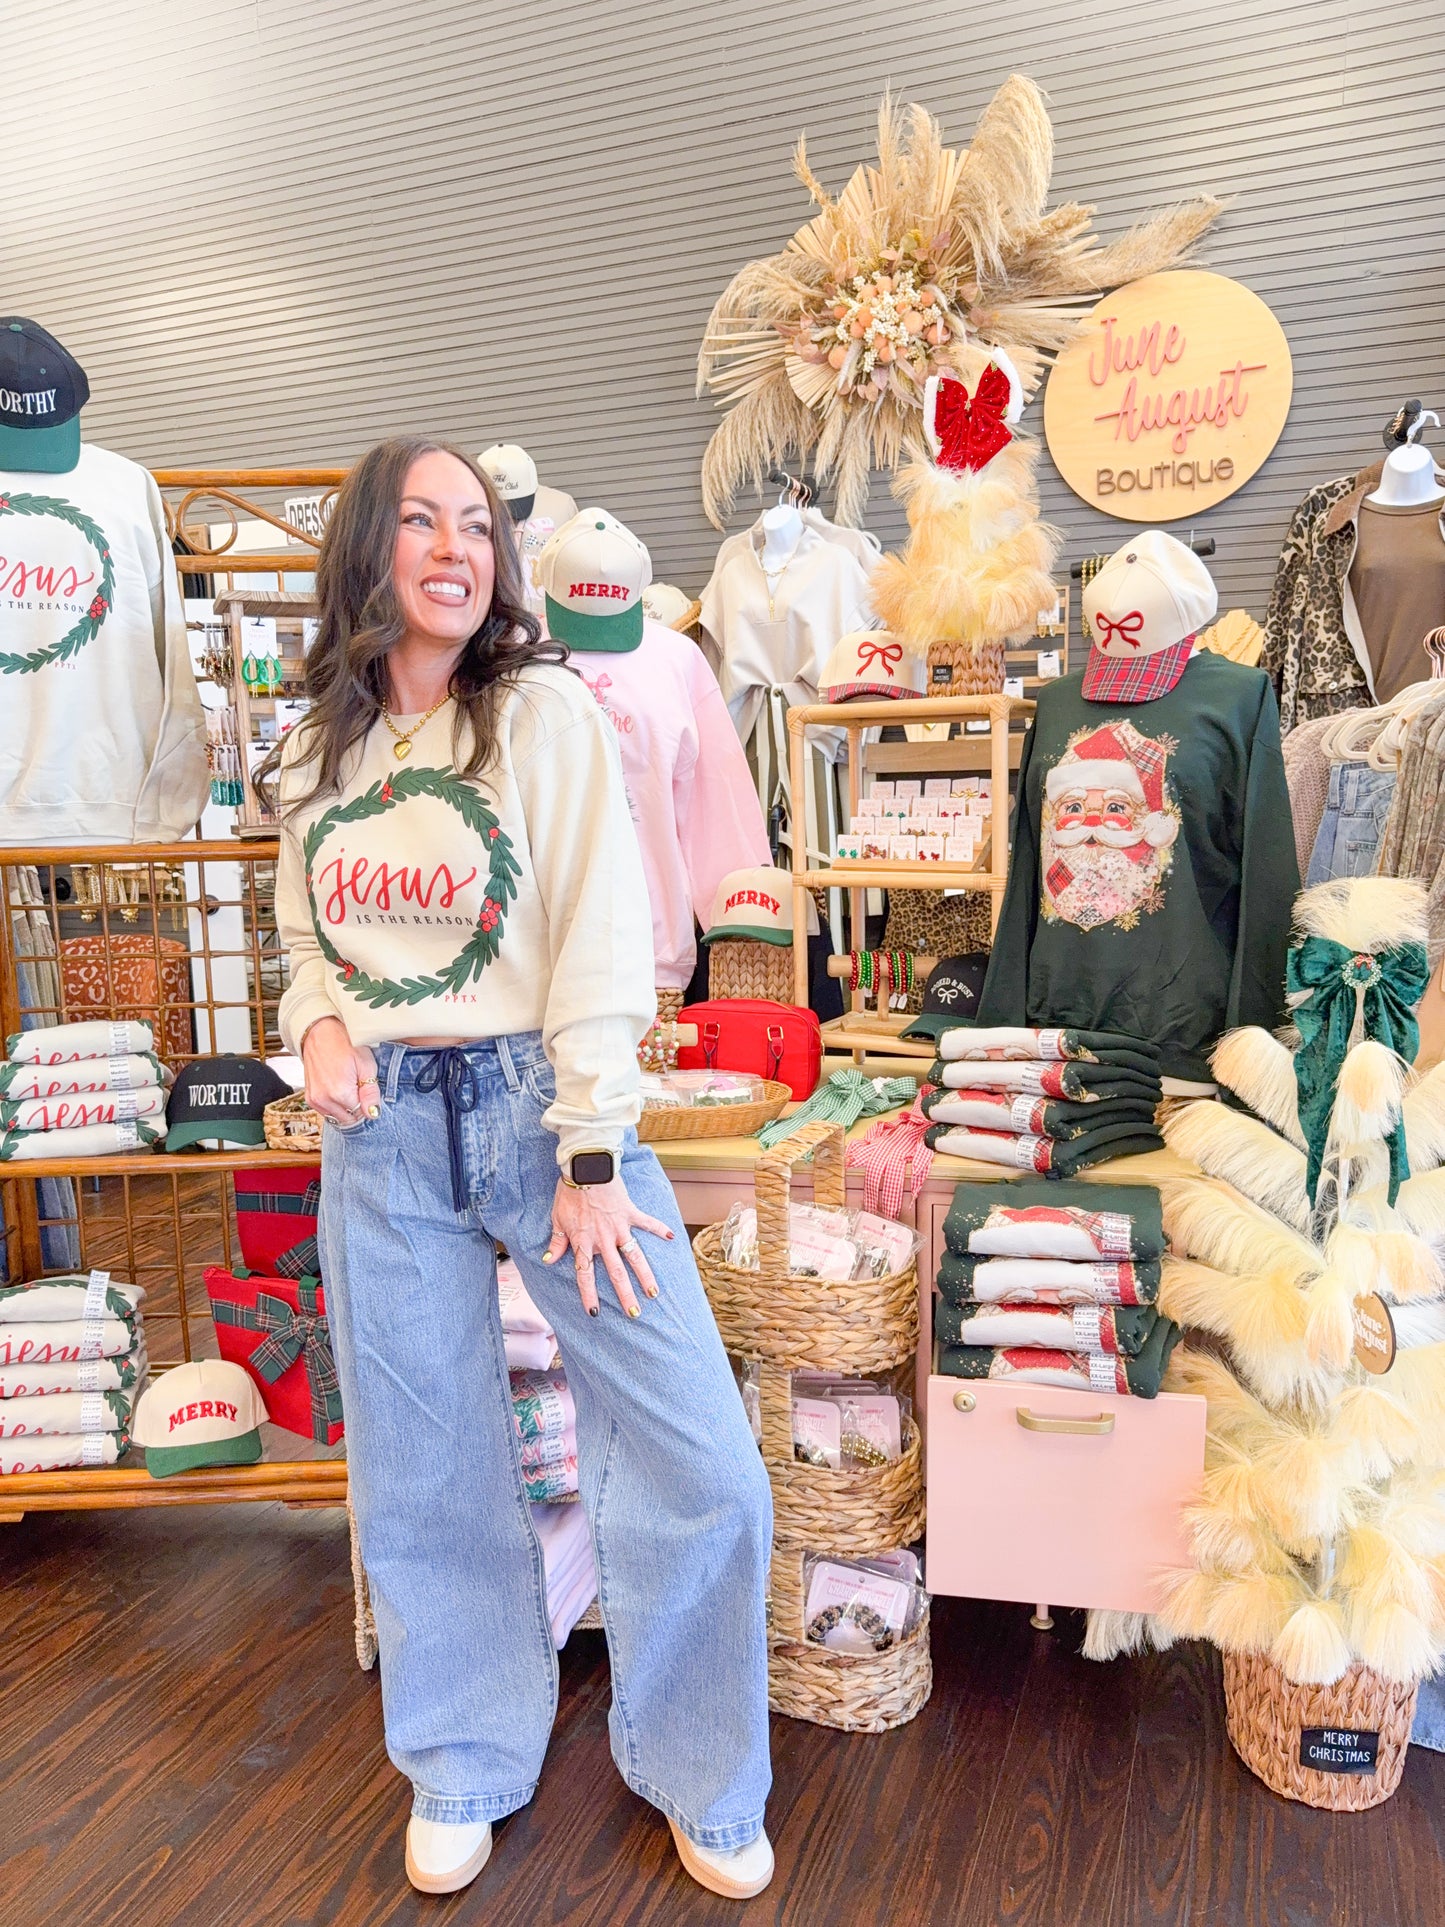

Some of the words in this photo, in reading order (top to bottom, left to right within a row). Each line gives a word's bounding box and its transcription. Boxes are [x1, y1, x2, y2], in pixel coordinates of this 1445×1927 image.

[1089, 317, 1186, 386] June
[0, 388, 57, 415] ORTHY
[1094, 360, 1267, 454] August
[1096, 457, 1234, 496] Boutique
[568, 583, 630, 601] MERRY
[8, 600, 33, 610] THE
[38, 602, 85, 614] REASON
[319, 847, 477, 925] jesus
[724, 889, 781, 917] MERRY
[356, 914, 372, 925] IS
[377, 914, 408, 925] THE
[412, 915, 474, 927] REASON
[444, 994, 478, 1004] PPTX
[956, 981, 975, 999] BUSY
[188, 1083, 252, 1107] WORTHY
[169, 1400, 239, 1433] MERRY
[1323, 1731, 1359, 1747] MERRY
[1309, 1745, 1371, 1763] CHRISTMAS
